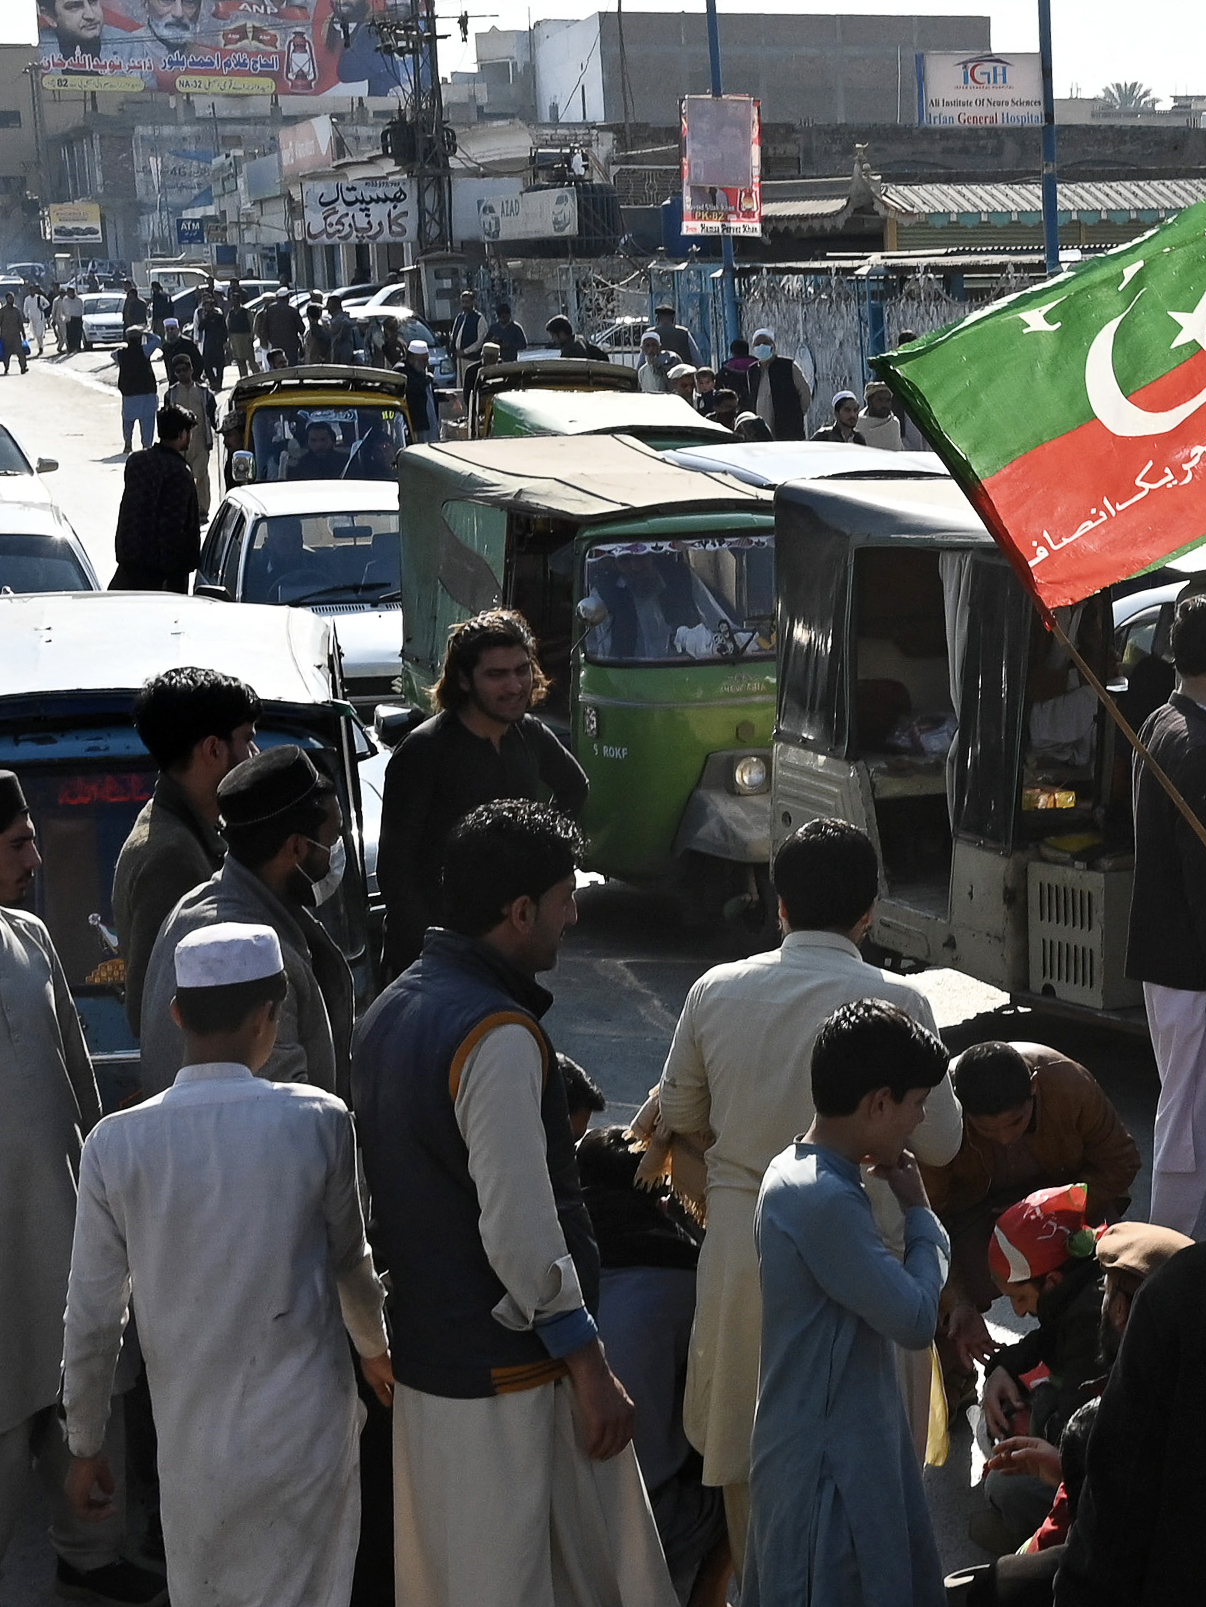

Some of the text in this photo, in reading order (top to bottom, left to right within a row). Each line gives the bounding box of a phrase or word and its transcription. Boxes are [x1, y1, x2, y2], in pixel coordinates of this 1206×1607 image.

[239, 2, 278, 15] ANP
[160, 50, 187, 71] بلور
[187, 52, 221, 70] احمد
[222, 52, 249, 74] غلام
[962, 63, 1008, 85] IGH
[929, 98, 1042, 107] Ali Institute Of Neuro Sciences
[928, 111, 1044, 126] Irfan General Hospital
[501, 199, 520, 217] AZAD
[181, 220, 200, 231] ATM
[742, 222, 758, 233] Khan
